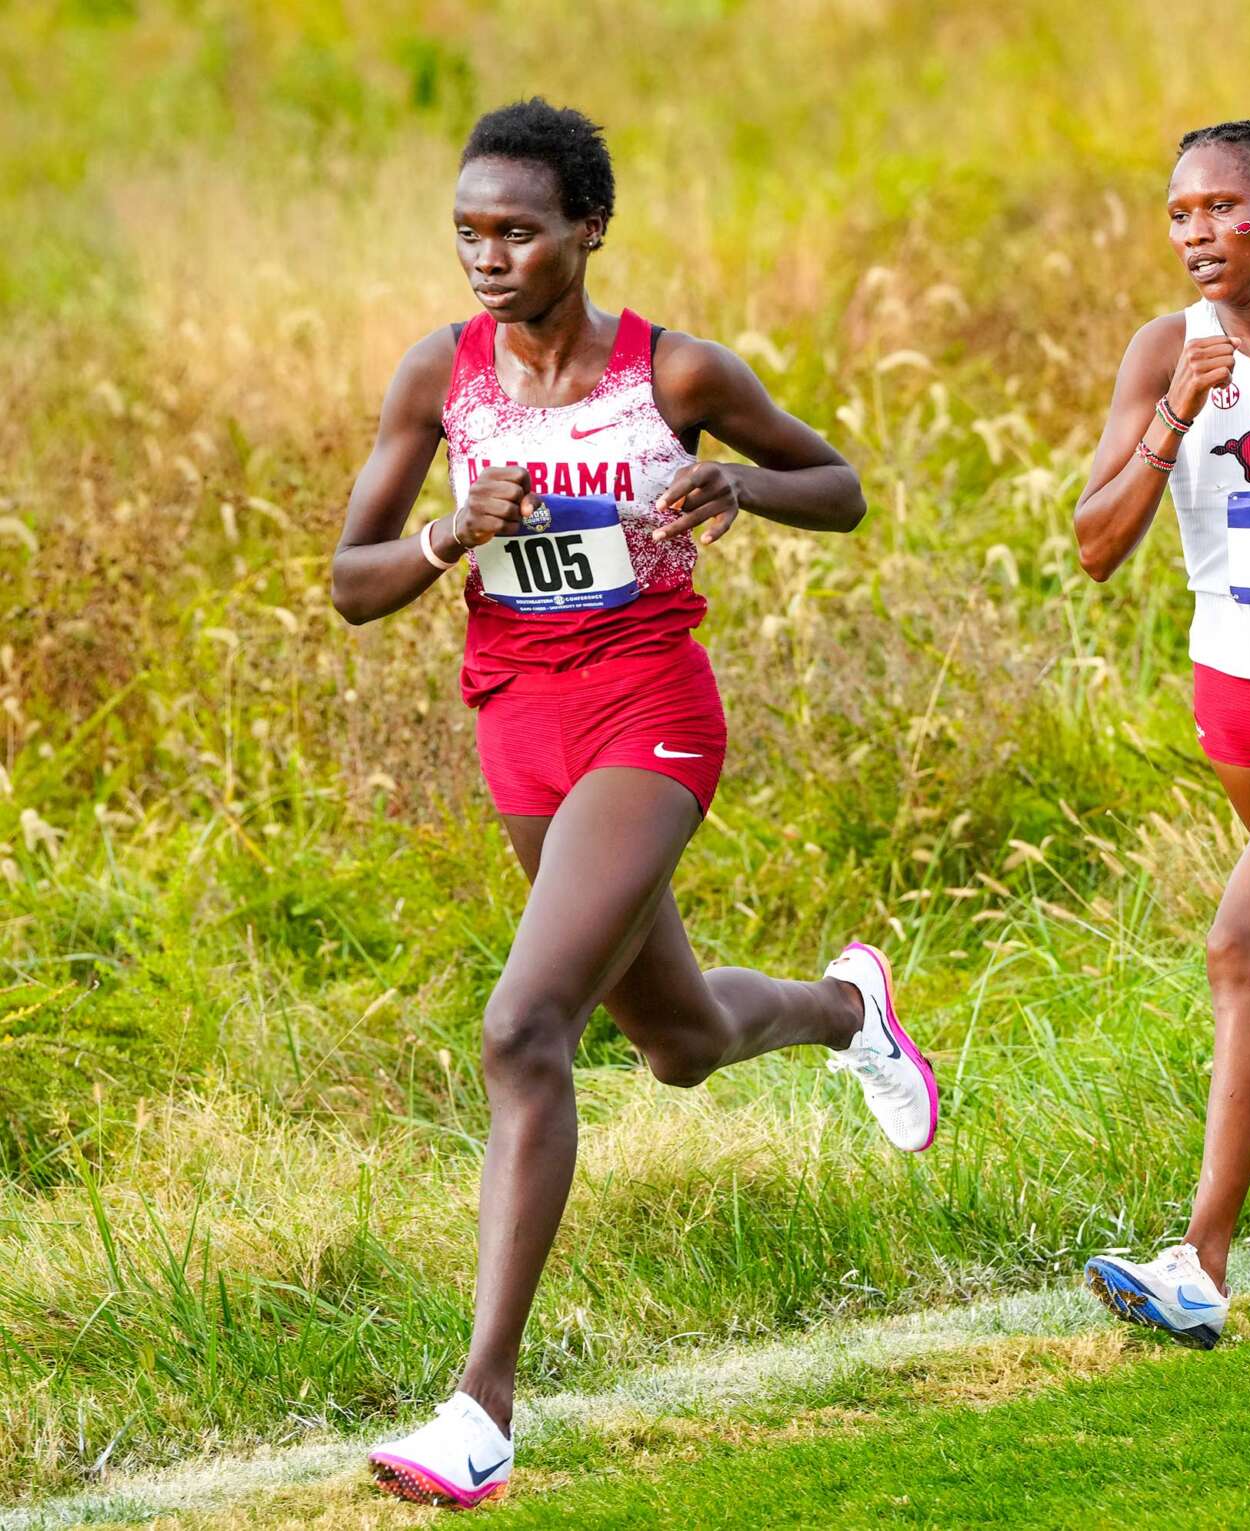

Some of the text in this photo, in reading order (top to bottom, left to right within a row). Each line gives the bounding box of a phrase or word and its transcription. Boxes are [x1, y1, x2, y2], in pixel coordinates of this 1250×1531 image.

[1211, 384, 1239, 410] SEC
[467, 458, 635, 502] ABAMA
[504, 533, 594, 593] 105
